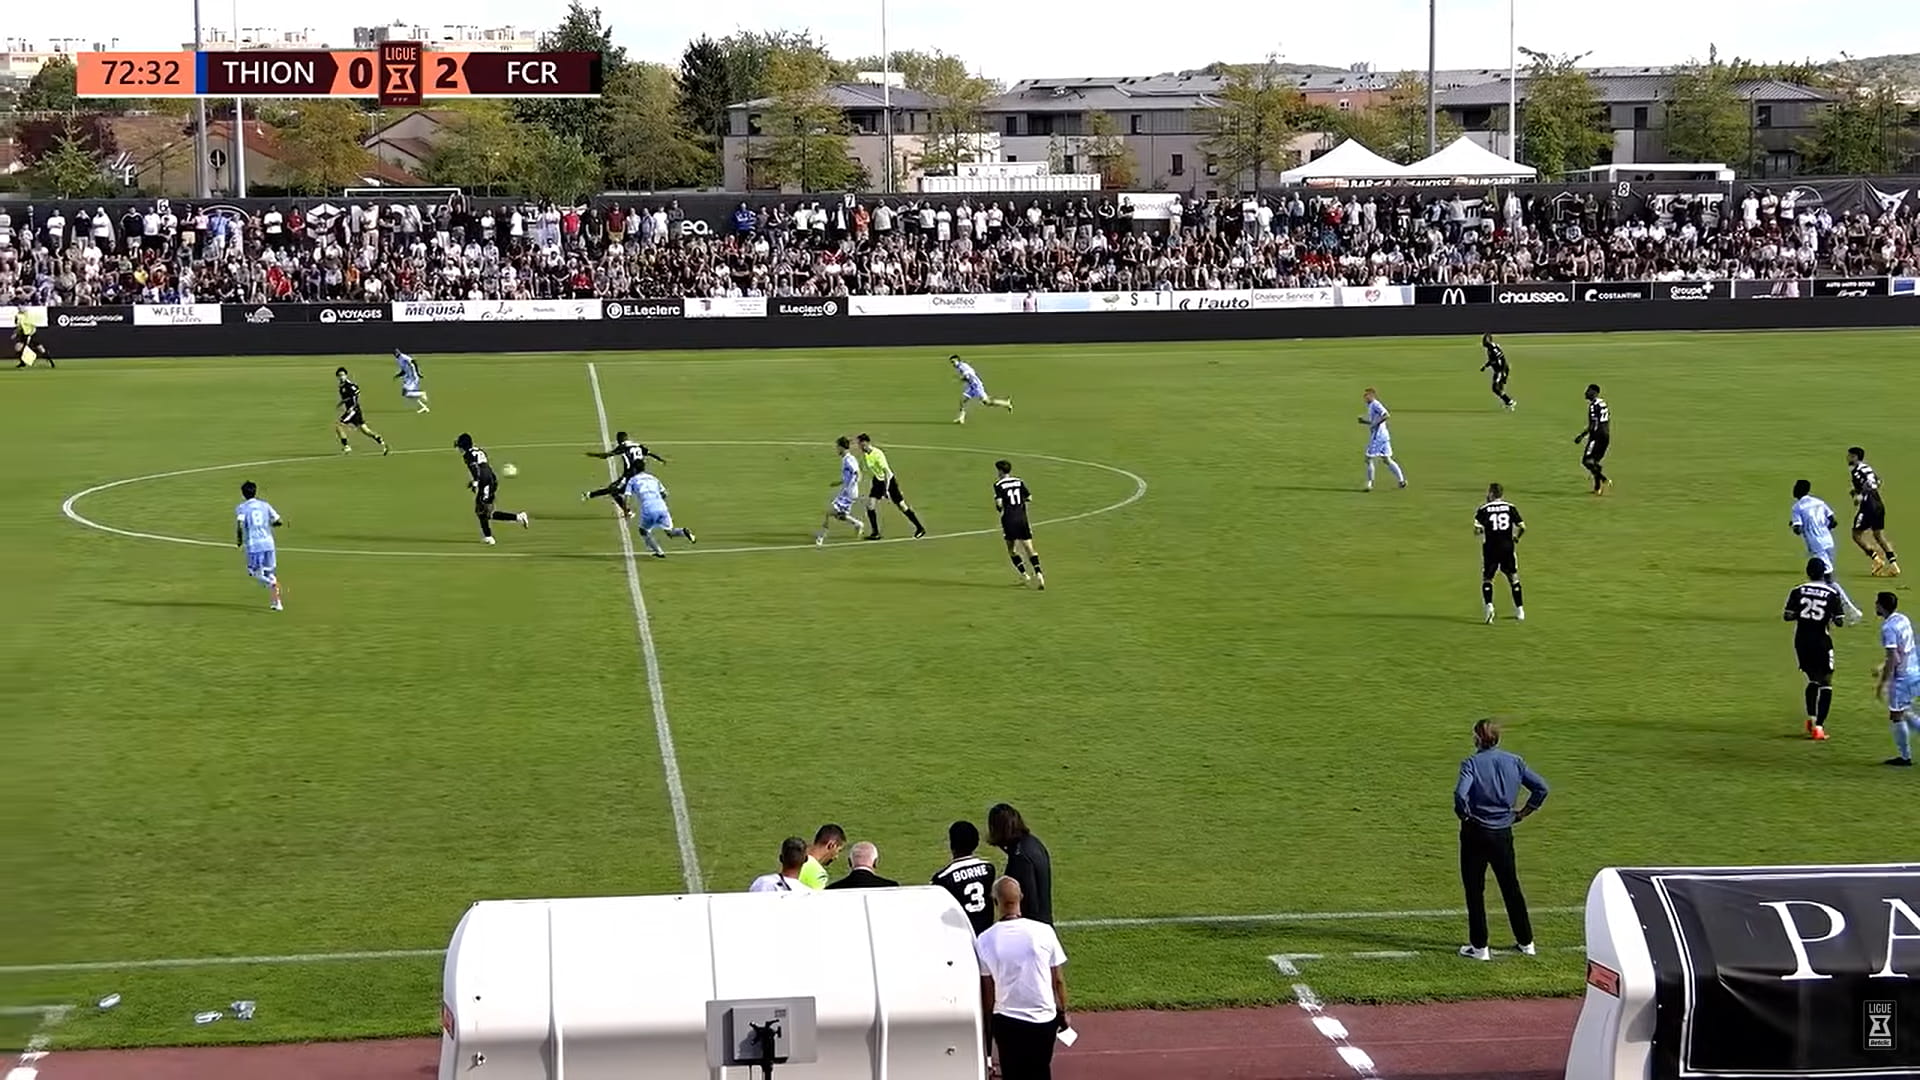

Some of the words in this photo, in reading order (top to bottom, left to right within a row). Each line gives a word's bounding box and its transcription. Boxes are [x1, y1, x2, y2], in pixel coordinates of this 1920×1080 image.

[1255, 292, 1285, 301] Chaleur
[1286, 291, 1314, 300] Service
[1670, 286, 1703, 296] Groupe
[152, 306, 195, 317] WAFFLE
[337, 309, 382, 319] VOYAGES
[623, 305, 681, 316] E.Leclerc
[780, 304, 823, 314] E.Leclerc
[1007, 488, 1022, 505] 11
[1488, 513, 1510, 531] 18
[1800, 597, 1828, 621] 25
[952, 864, 989, 883] BORNE
[963, 881, 987, 913] 3
